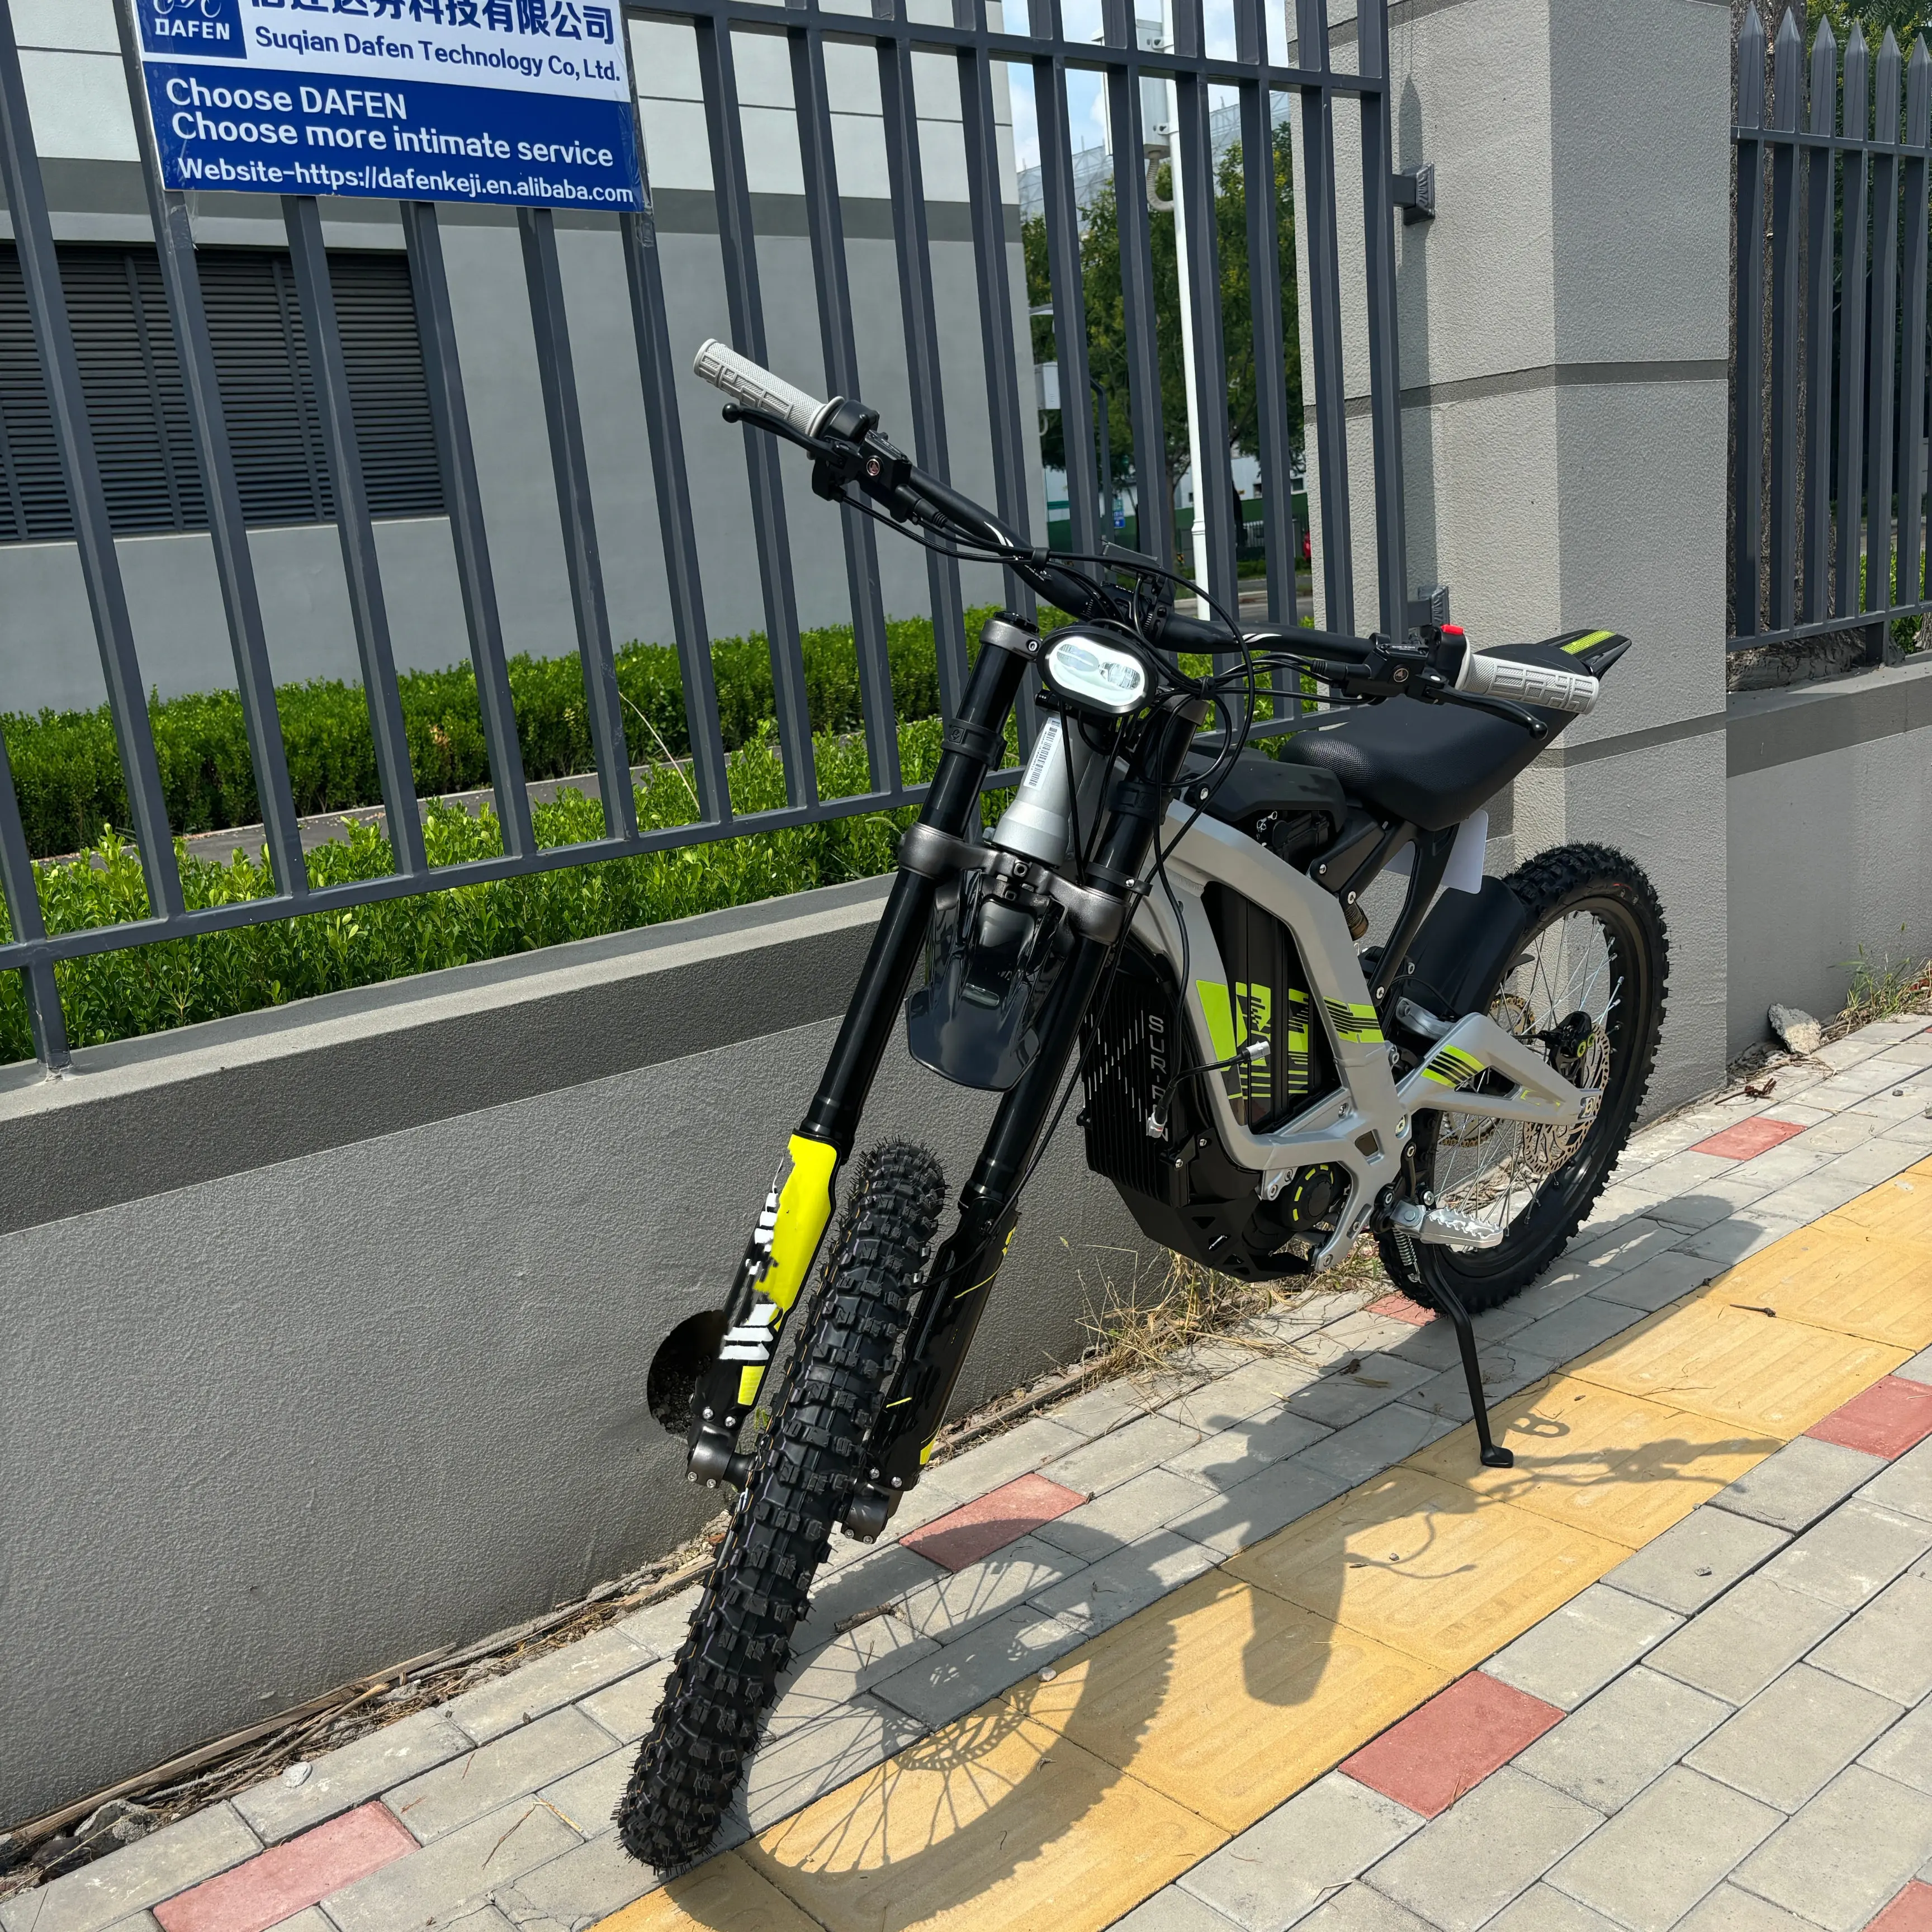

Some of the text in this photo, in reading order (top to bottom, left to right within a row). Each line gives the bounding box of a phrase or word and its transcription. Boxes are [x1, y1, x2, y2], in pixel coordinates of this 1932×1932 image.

[154, 18, 230, 40] DAFEN
[255, 26, 339, 55] Suqian
[344, 33, 414, 59] Dafen
[418, 40, 543, 77] Technology
[166, 77, 407, 120] Choose DAFEN
[172, 111, 613, 167] Choose more intimate service
